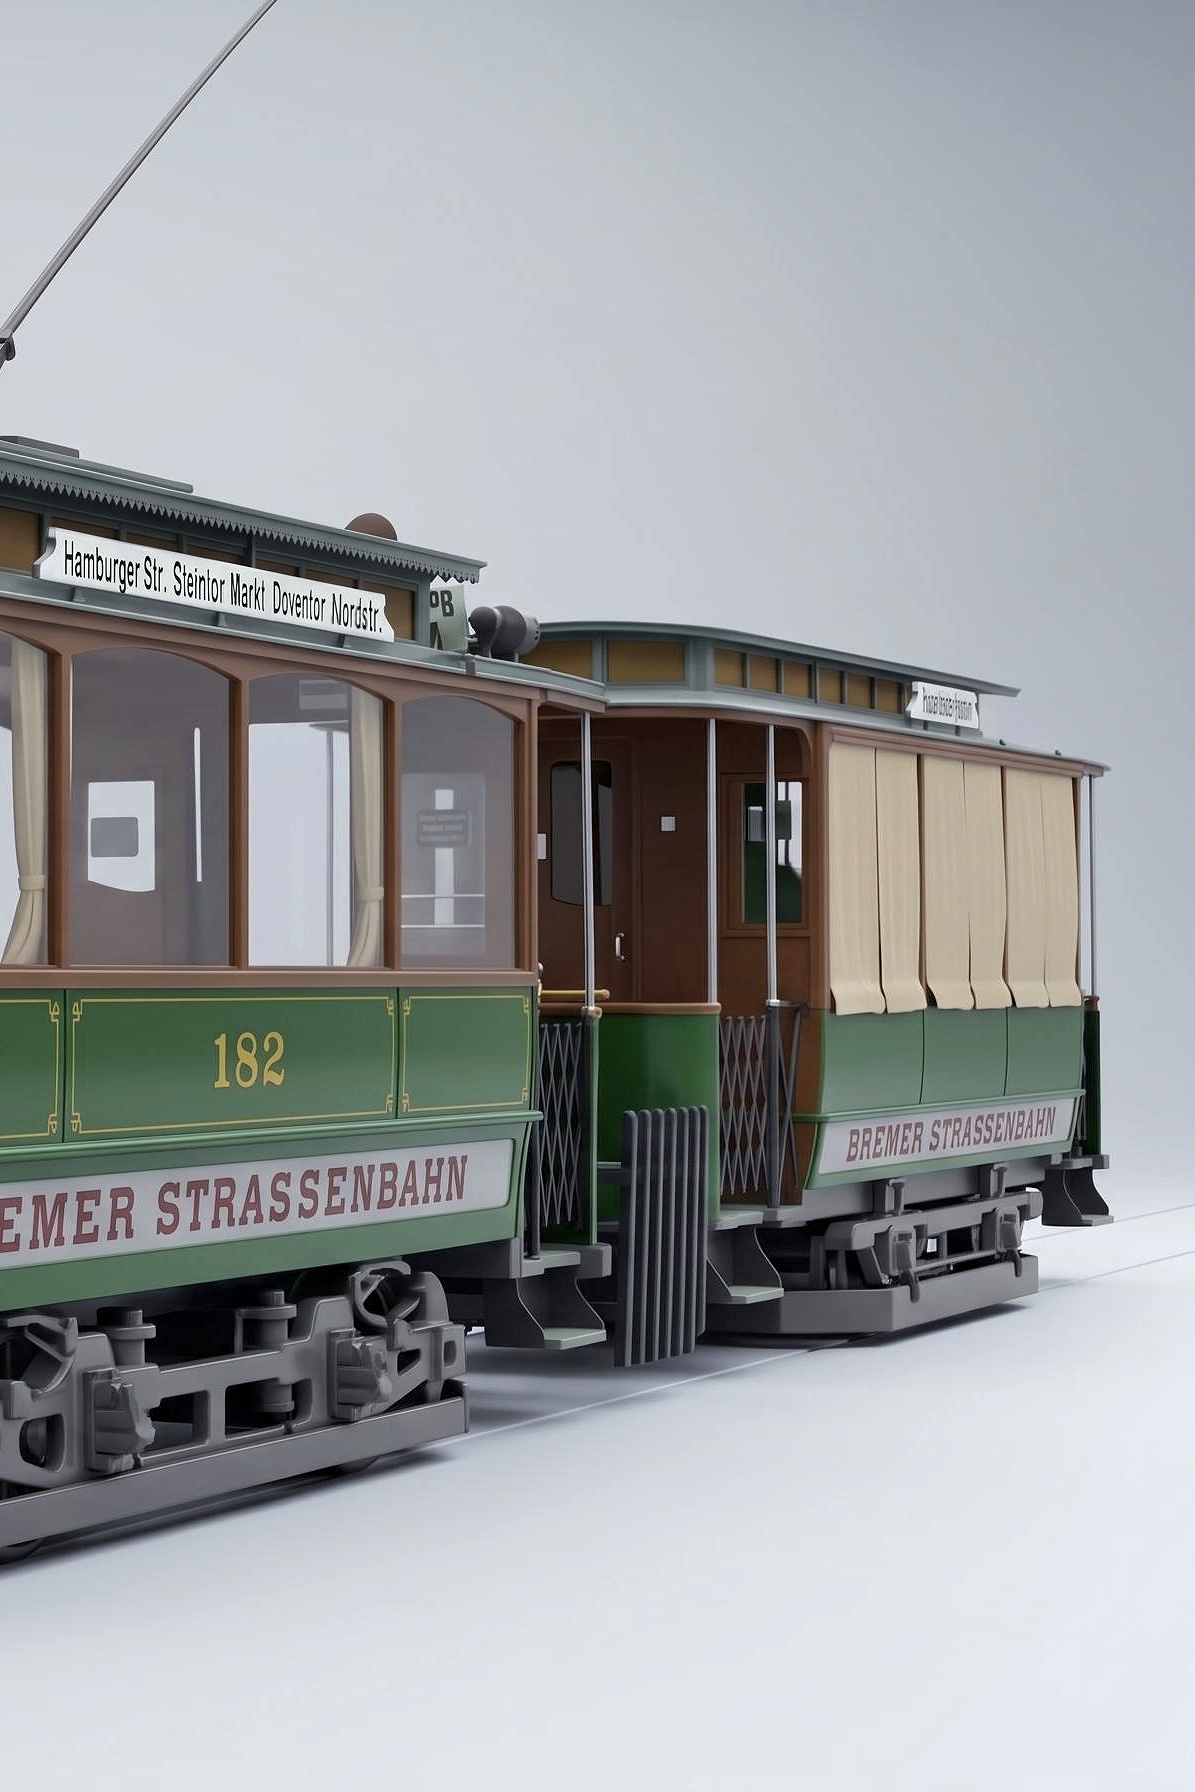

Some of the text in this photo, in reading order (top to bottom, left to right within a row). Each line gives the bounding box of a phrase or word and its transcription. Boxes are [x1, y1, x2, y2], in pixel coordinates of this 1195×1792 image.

[64, 539, 140, 593] Hamburger
[143, 555, 167, 593] Str.
[230, 572, 265, 612] Markt
[273, 581, 325, 622] Doventor
[331, 593, 382, 633] Nordstr.
[214, 1031, 284, 1088] 182
[846, 1107, 1056, 1162] BREMER STRASSENBAHN
[156, 1155, 468, 1236] STRASSENBAHN
